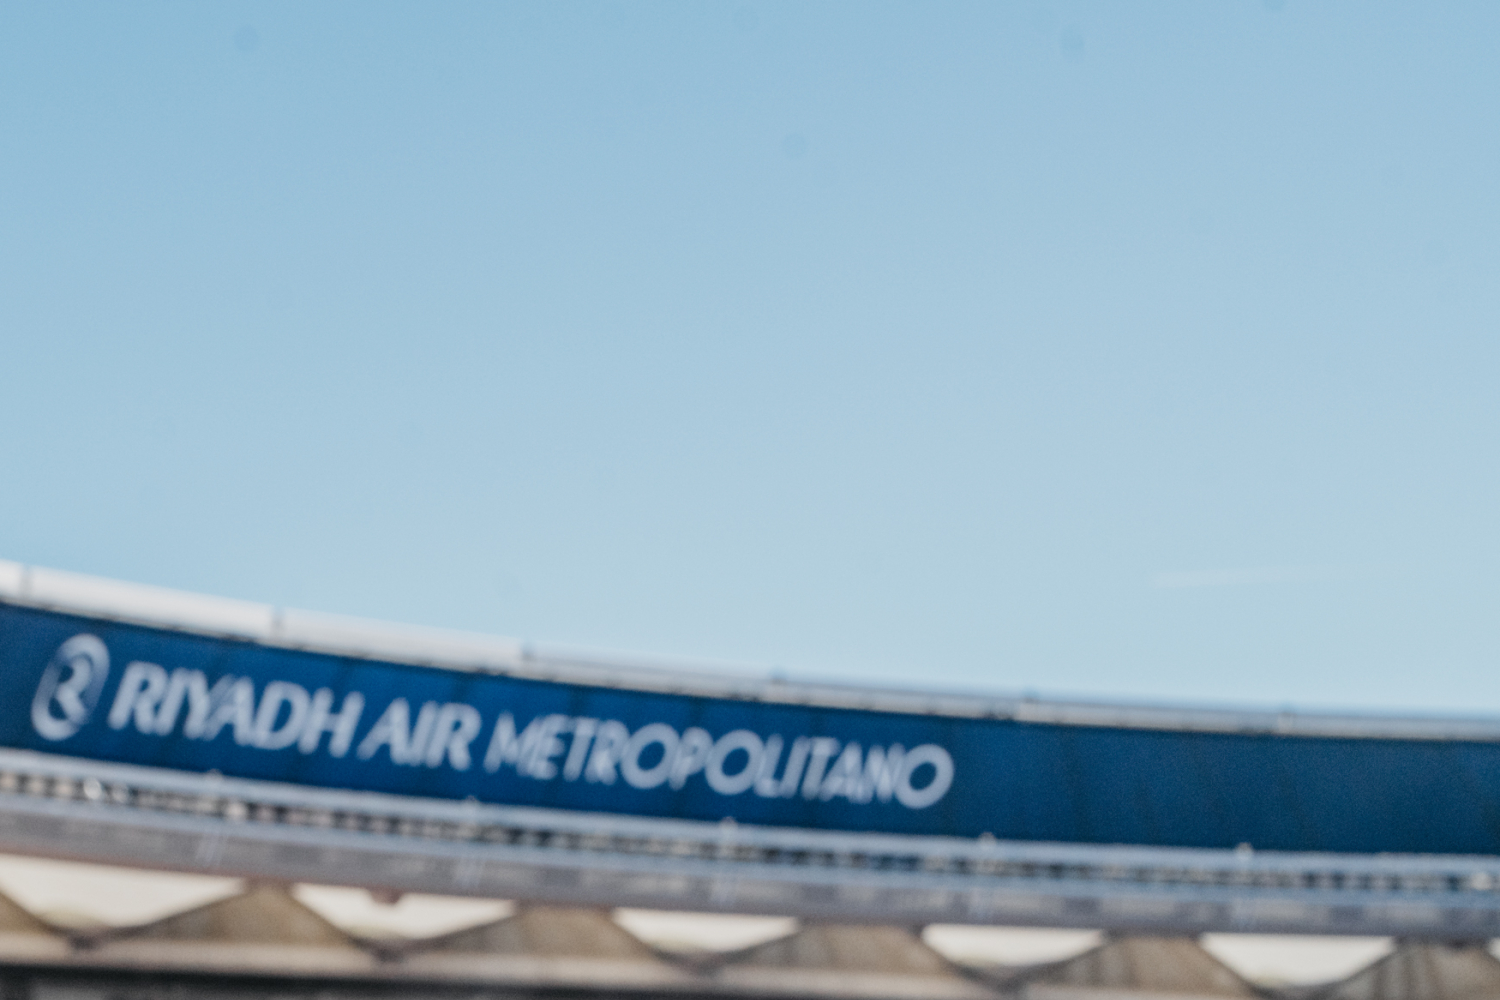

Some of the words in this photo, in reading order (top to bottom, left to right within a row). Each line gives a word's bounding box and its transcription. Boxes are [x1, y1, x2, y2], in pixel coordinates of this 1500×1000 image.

[106, 660, 366, 758] RIYADH
[355, 697, 482, 772] AIR
[483, 711, 955, 810] METROPOLITANO
